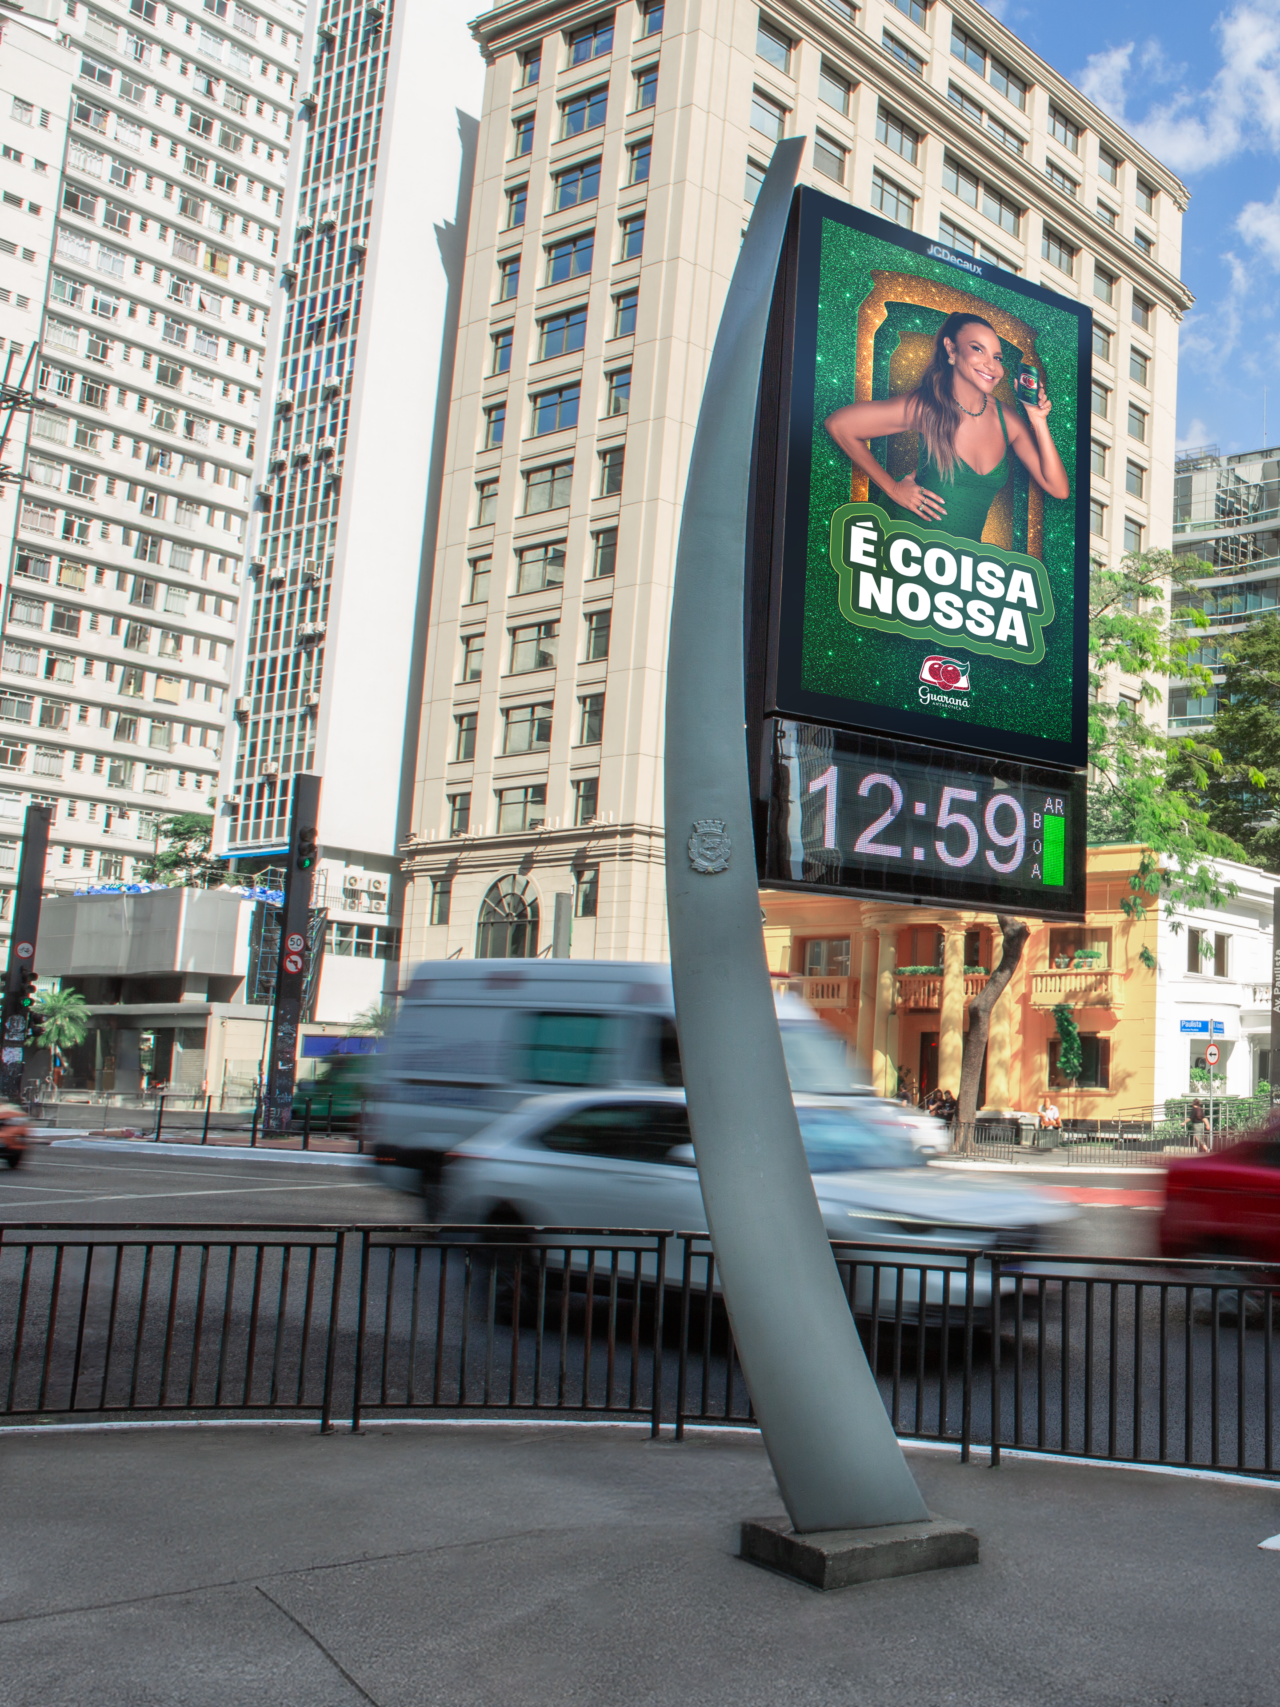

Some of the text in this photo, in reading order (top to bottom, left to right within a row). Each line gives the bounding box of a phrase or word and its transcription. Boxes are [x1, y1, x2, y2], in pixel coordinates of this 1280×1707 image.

[927, 243, 983, 276] JCDecaux
[849, 521, 1039, 609] É COISA
[858, 570, 1029, 647] NOSSA
[918, 685, 971, 708] Guaraná
[809, 765, 1026, 873] 12:59
[1044, 796, 1065, 815] AR
[289, 937, 302, 946] 50
[1181, 1020, 1202, 1028] Paulista
